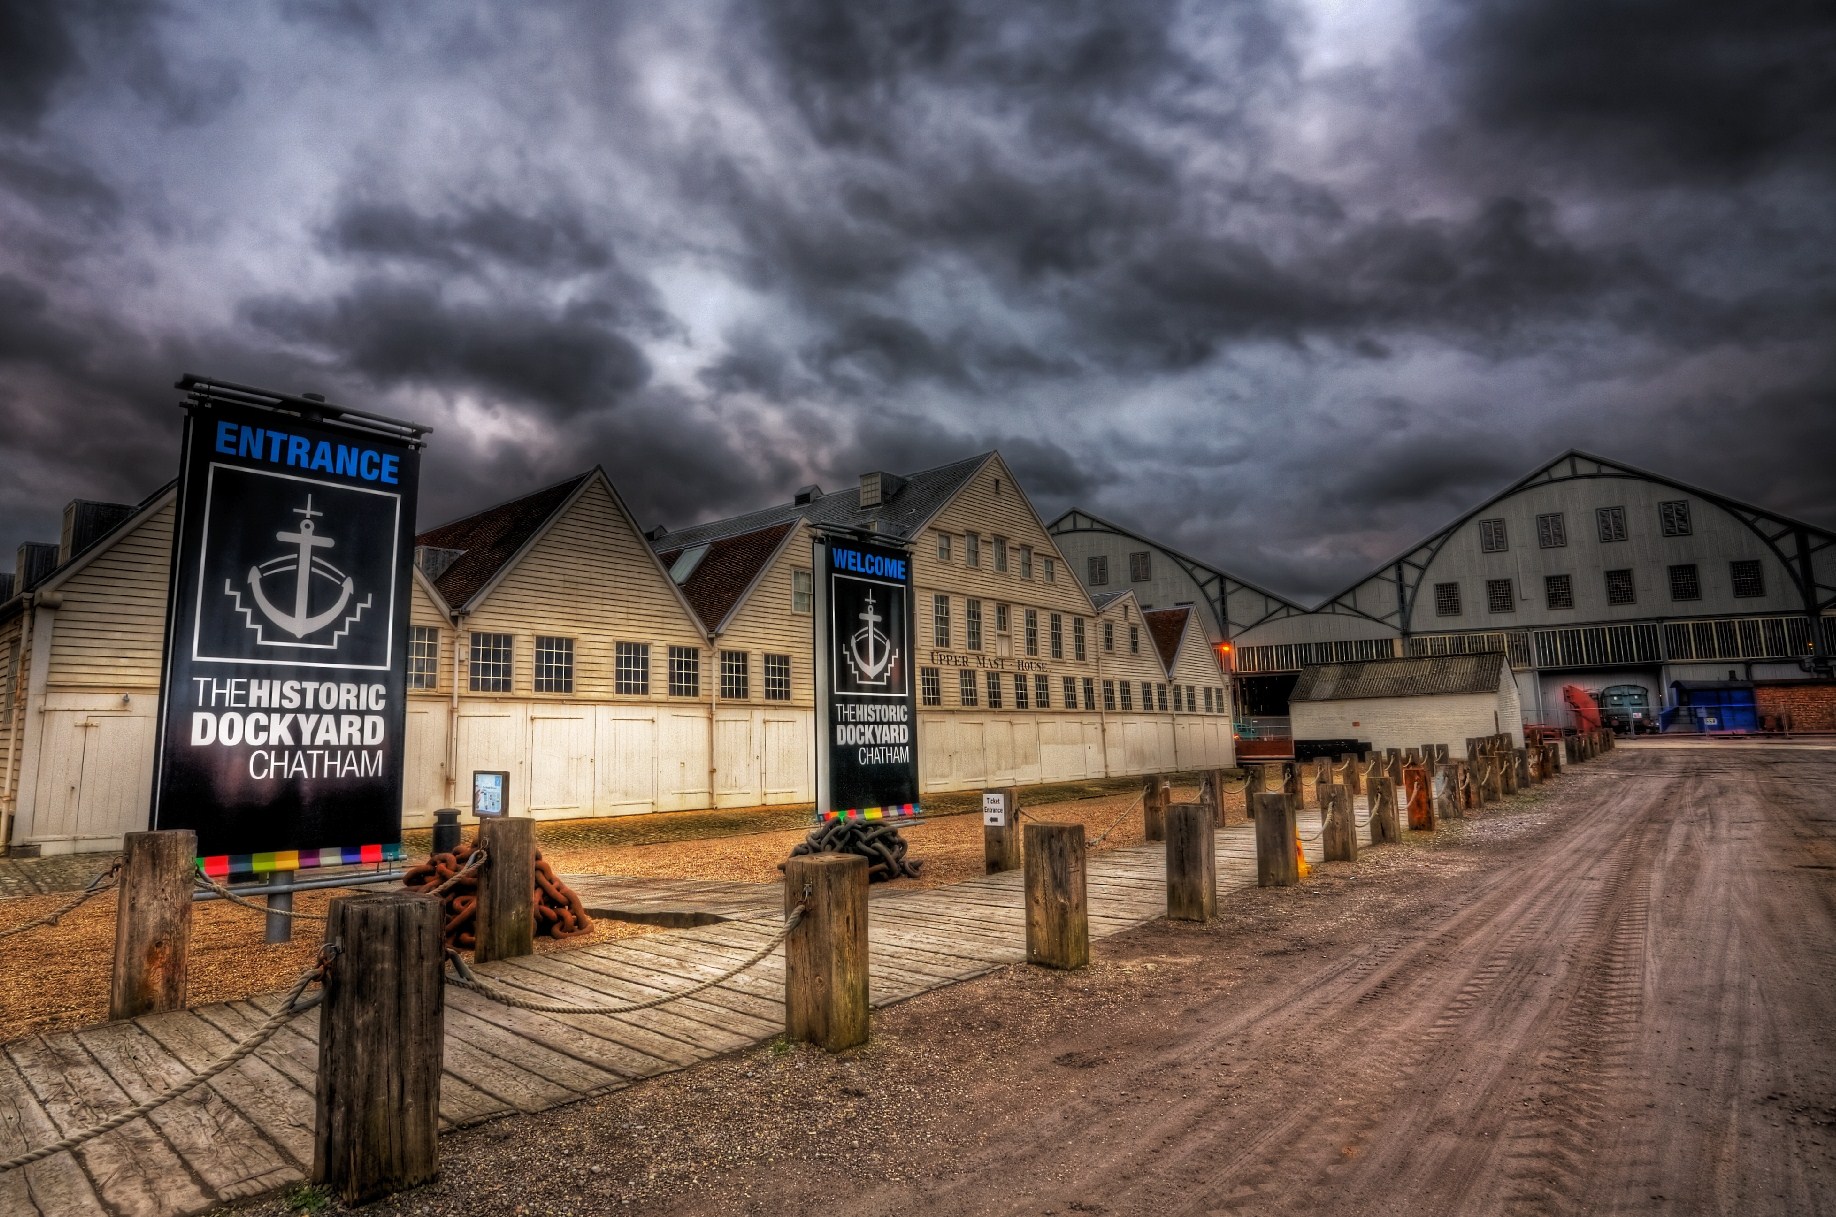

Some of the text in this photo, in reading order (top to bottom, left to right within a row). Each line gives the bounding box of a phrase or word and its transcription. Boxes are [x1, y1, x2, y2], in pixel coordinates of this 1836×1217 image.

[215, 420, 401, 485] ENTRANCE
[833, 548, 905, 579] WELCOME
[930, 651, 969, 667] UPPER
[976, 655, 1005, 669] MAST
[192, 677, 385, 710] THE HISTORIC
[835, 704, 908, 722] THE HISTORIC
[190, 712, 385, 746] DOCKYARD
[836, 724, 909, 746] DOCKYARD
[249, 749, 382, 779] CHATHAM
[858, 746, 909, 765] CHATHAM
